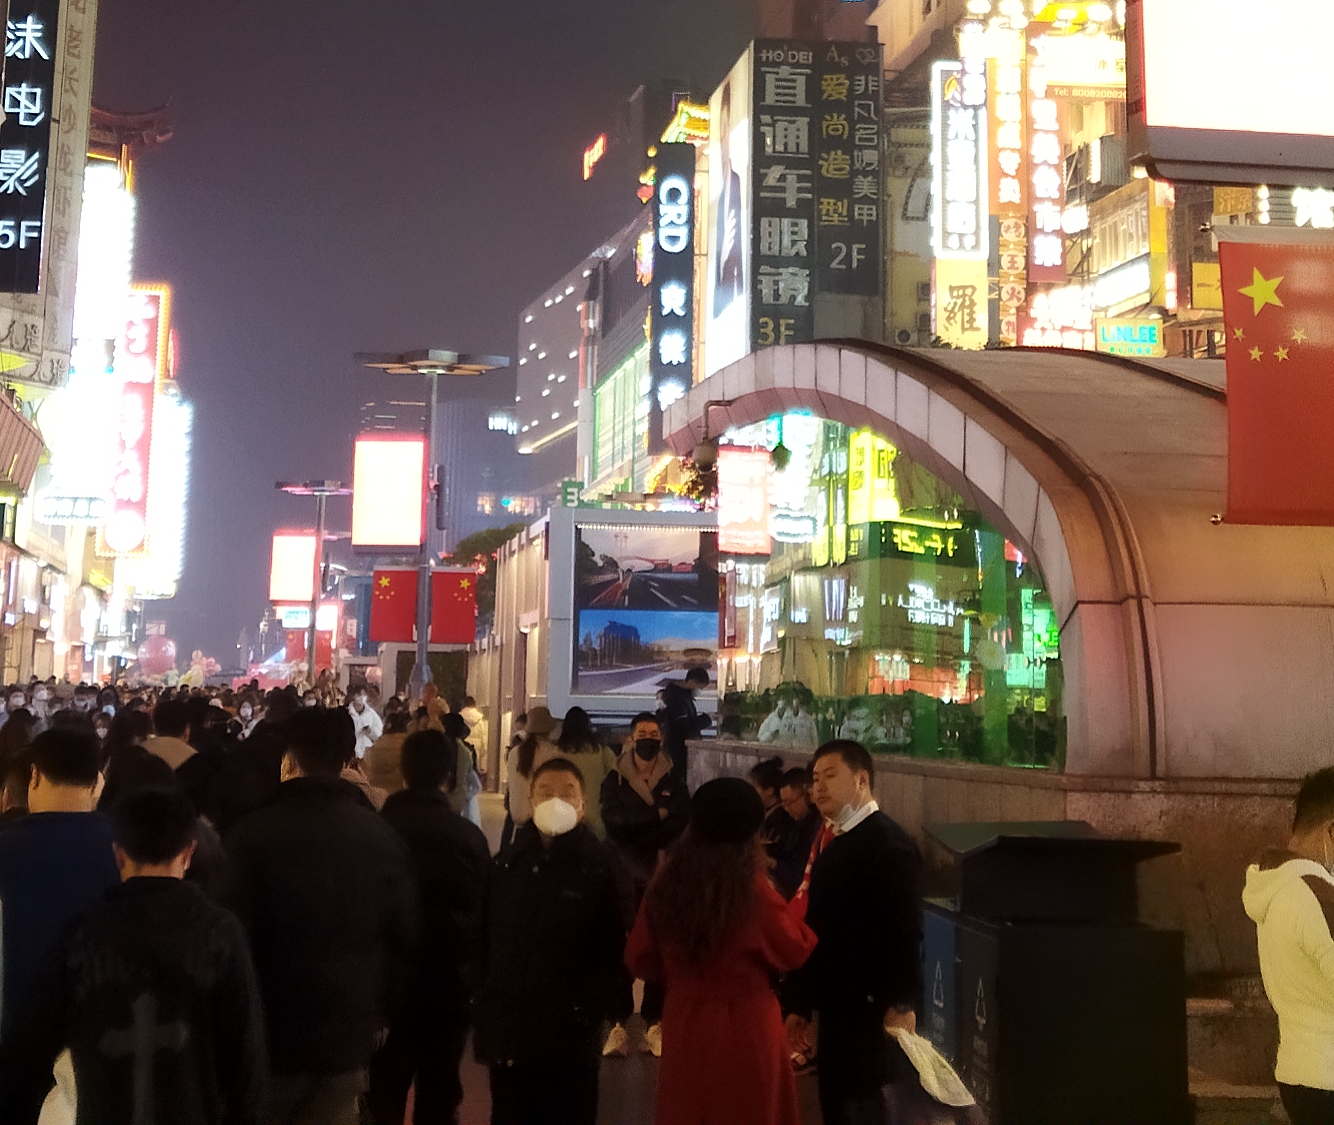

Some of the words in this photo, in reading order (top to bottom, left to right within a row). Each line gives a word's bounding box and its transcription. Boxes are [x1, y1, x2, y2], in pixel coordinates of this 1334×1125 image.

[757, 65, 813, 307] 直通车眼镜
[818, 74, 851, 226] 爱尚造型
[829, 242, 866, 269] 2F
[758, 317, 795, 345] 3F
